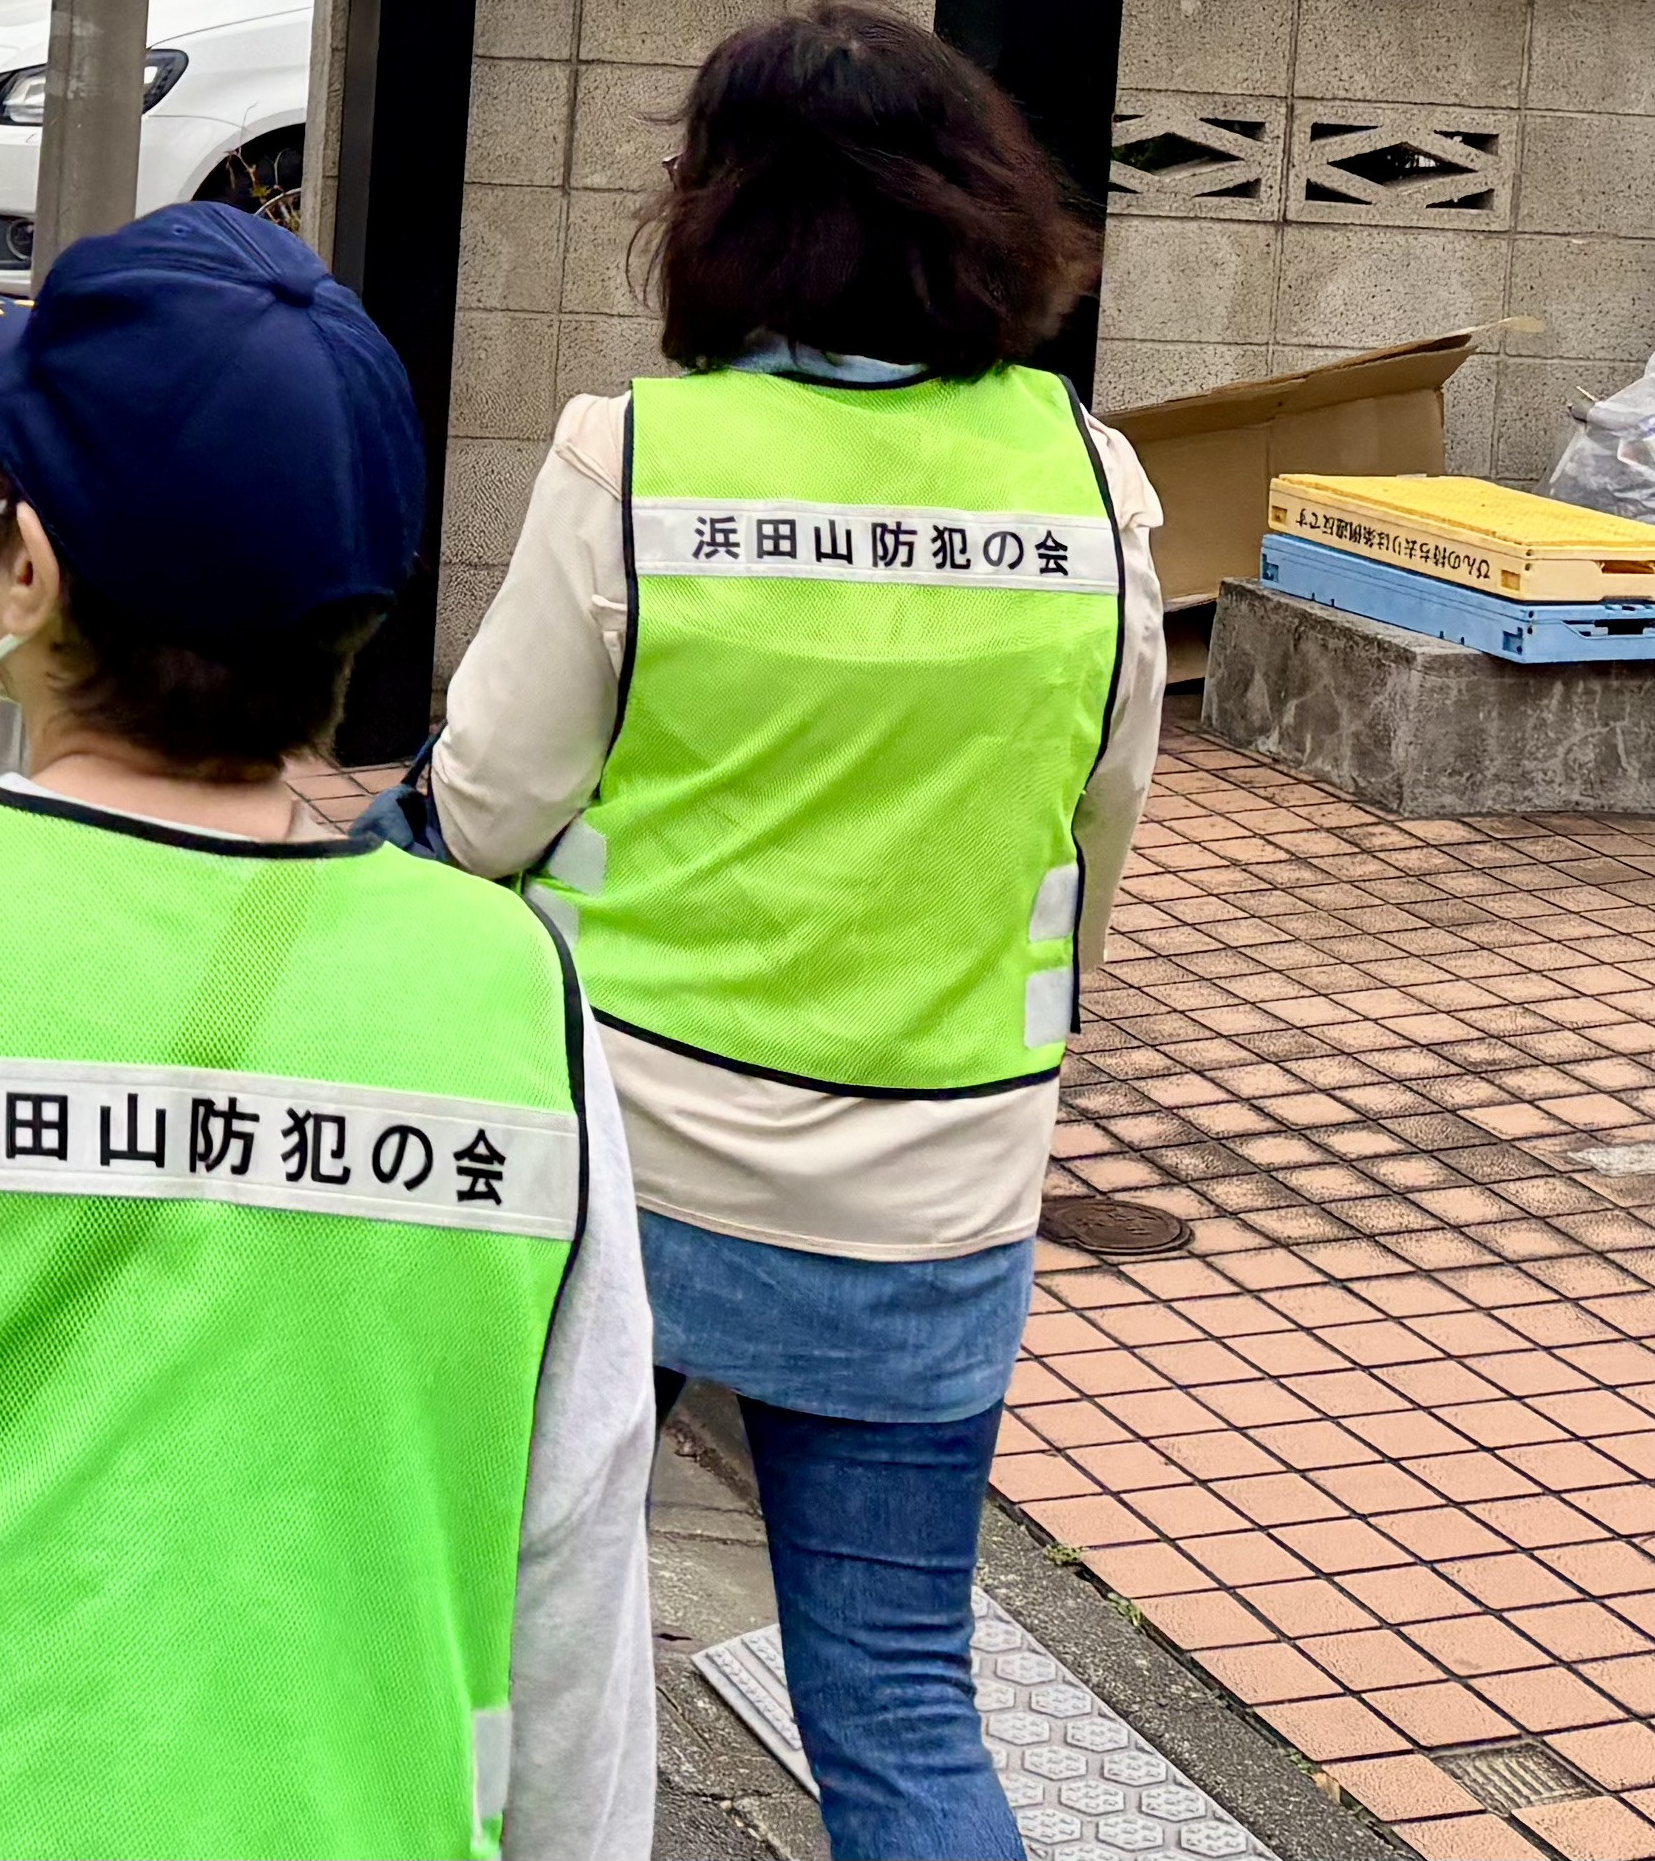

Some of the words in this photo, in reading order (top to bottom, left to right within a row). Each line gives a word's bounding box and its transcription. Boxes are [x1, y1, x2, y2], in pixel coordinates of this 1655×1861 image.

[691, 514, 1071, 578] 浜田山防犯の会
[1295, 506, 1492, 580] びんの持ち去りは条例違反です
